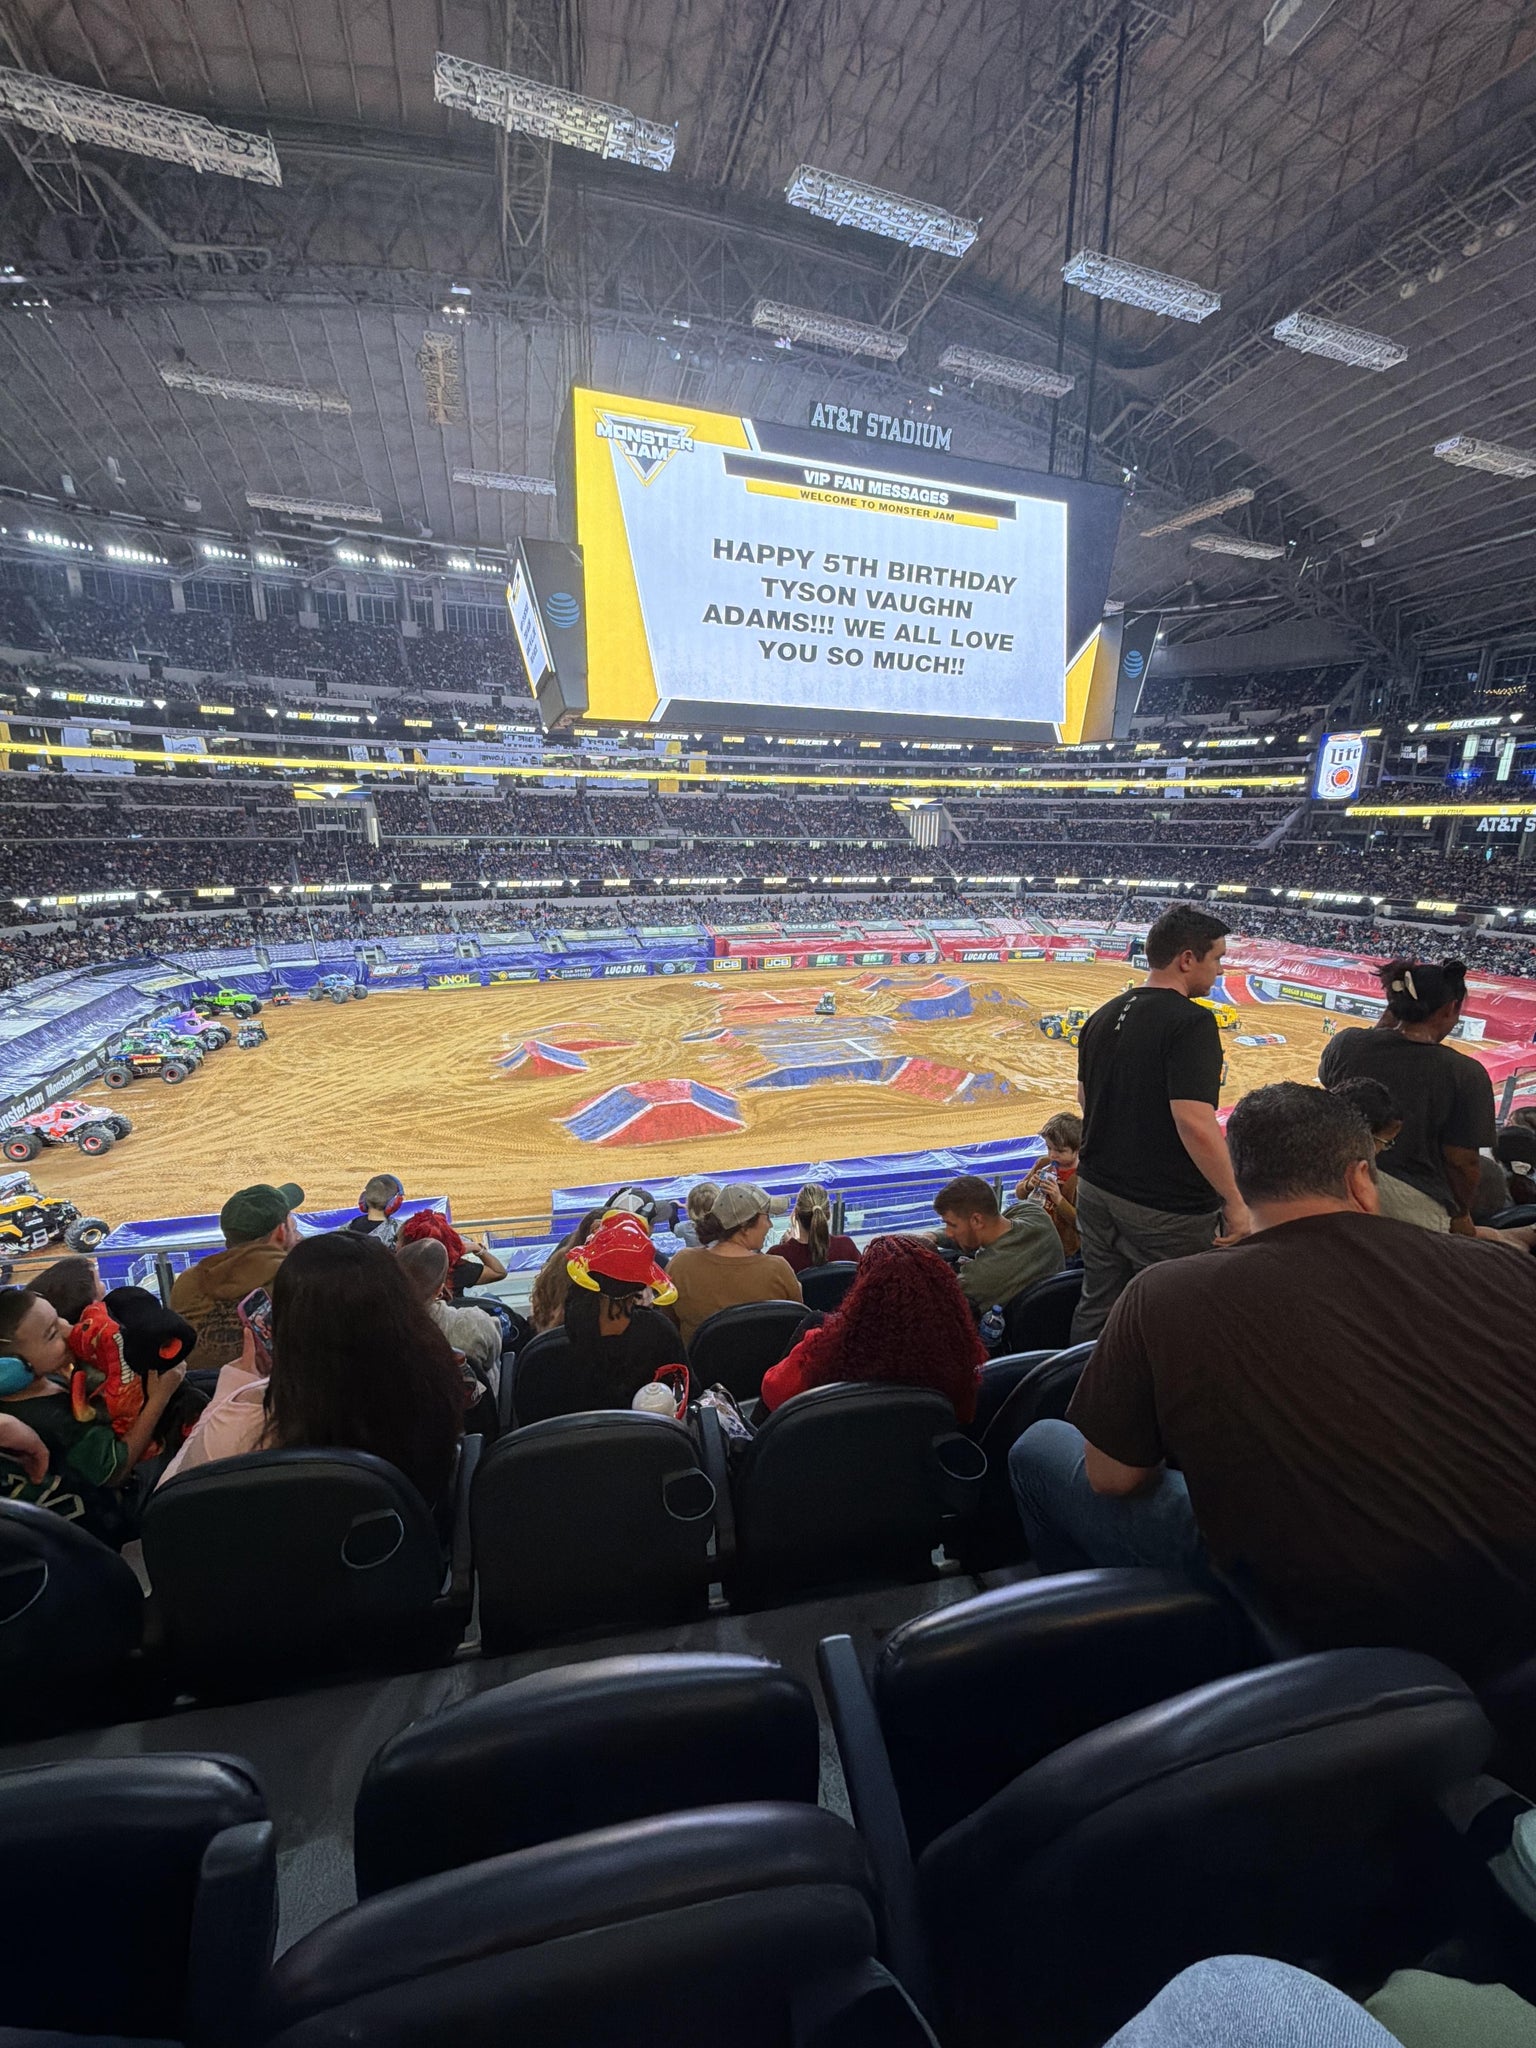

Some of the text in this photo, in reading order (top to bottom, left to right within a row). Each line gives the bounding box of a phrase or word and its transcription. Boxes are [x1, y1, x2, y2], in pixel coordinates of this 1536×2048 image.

[811, 402, 952, 451] AT&T STADIUM
[596, 422, 695, 452] MONSTER
[625, 442, 668, 460] JAM
[804, 469, 949, 506] VIP FAN MESSAGES
[800, 490, 955, 522] WELCOME TO MONSTER JAM
[713, 538, 1018, 595] HAPPY 5TH BIRTHDAY
[761, 577, 973, 619] TYSON VAUGHN
[702, 604, 1014, 652] ADAMS!!! WE ALL LOVE
[758, 640, 965, 676] YOU SO MUCH!!
[1329, 747, 1361, 766] Lite
[1476, 817, 1522, 832] AT&T
[716, 960, 739, 969] JCB
[766, 958, 789, 967] JCB
[817, 954, 838, 963] BKT
[863, 953, 884, 962] BKT
[964, 951, 999, 961] LUCAS OIL
[605, 963, 647, 975] LUCAS OIL
[438, 974, 469, 985] UNOH
[1282, 987, 1299, 996] MORGAN
[1304, 991, 1322, 1001] MORGAN
[1114, 996, 1137, 1031] PUMA
[45, 1058, 99, 1098] MonsterJam.com
